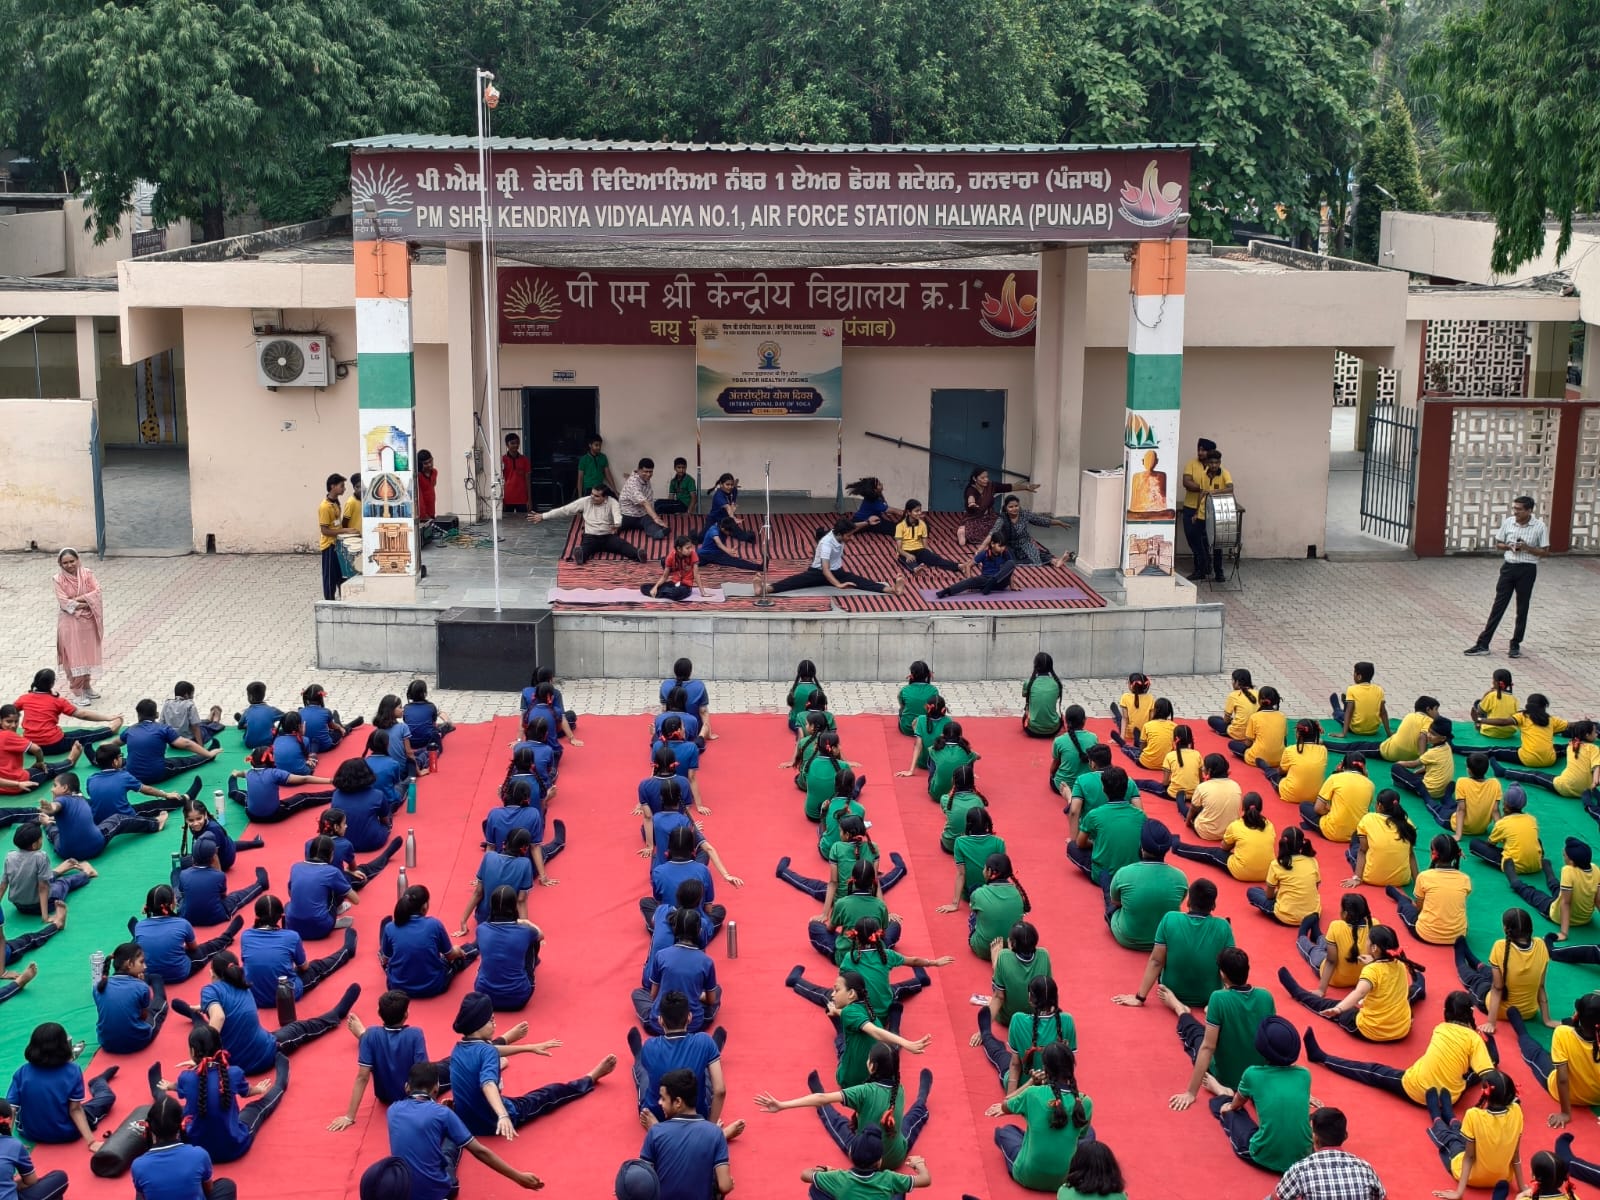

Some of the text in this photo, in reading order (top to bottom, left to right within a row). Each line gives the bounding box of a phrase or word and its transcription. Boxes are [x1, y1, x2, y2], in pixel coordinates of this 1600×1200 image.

[532, 165, 584, 191] ਕੇਂਦਰੀ
[591, 166, 717, 191] ਵਿਦਿਆਲਿਆ
[724, 166, 767, 190] ਨੰਬਰ
[775, 172, 784, 190] 1
[791, 165, 841, 190] ਏਅਰ
[848, 165, 891, 190] ਫੋਰਸ
[897, 164, 962, 193] ਸਟੇਸ਼ਨ,
[968, 171, 1039, 190] ਹਲਵਾਰਾ
[1045, 165, 1111, 193] (ਪੰਜਾਬ)
[416, 205, 443, 227] PM
[449, 205, 492, 228] SHRI
[498, 205, 591, 227] KENDRIYA
[594, 205, 694, 227] VIDYALAYA
[699, 204, 745, 230] NO.1,
[750, 204, 782, 227] AIR
[787, 204, 849, 227] FORCE
[854, 203, 929, 227] STATION
[935, 203, 1024, 226] HALWARA
[1029, 202, 1114, 231] (PUNJAB)
[565, 271, 599, 309] पी
[608, 281, 650, 315] एम
[662, 272, 696, 310] श्री
[706, 272, 796, 315] केन्द्रीय
[805, 272, 910, 312] विद्यालय
[649, 320, 682, 343] वायु
